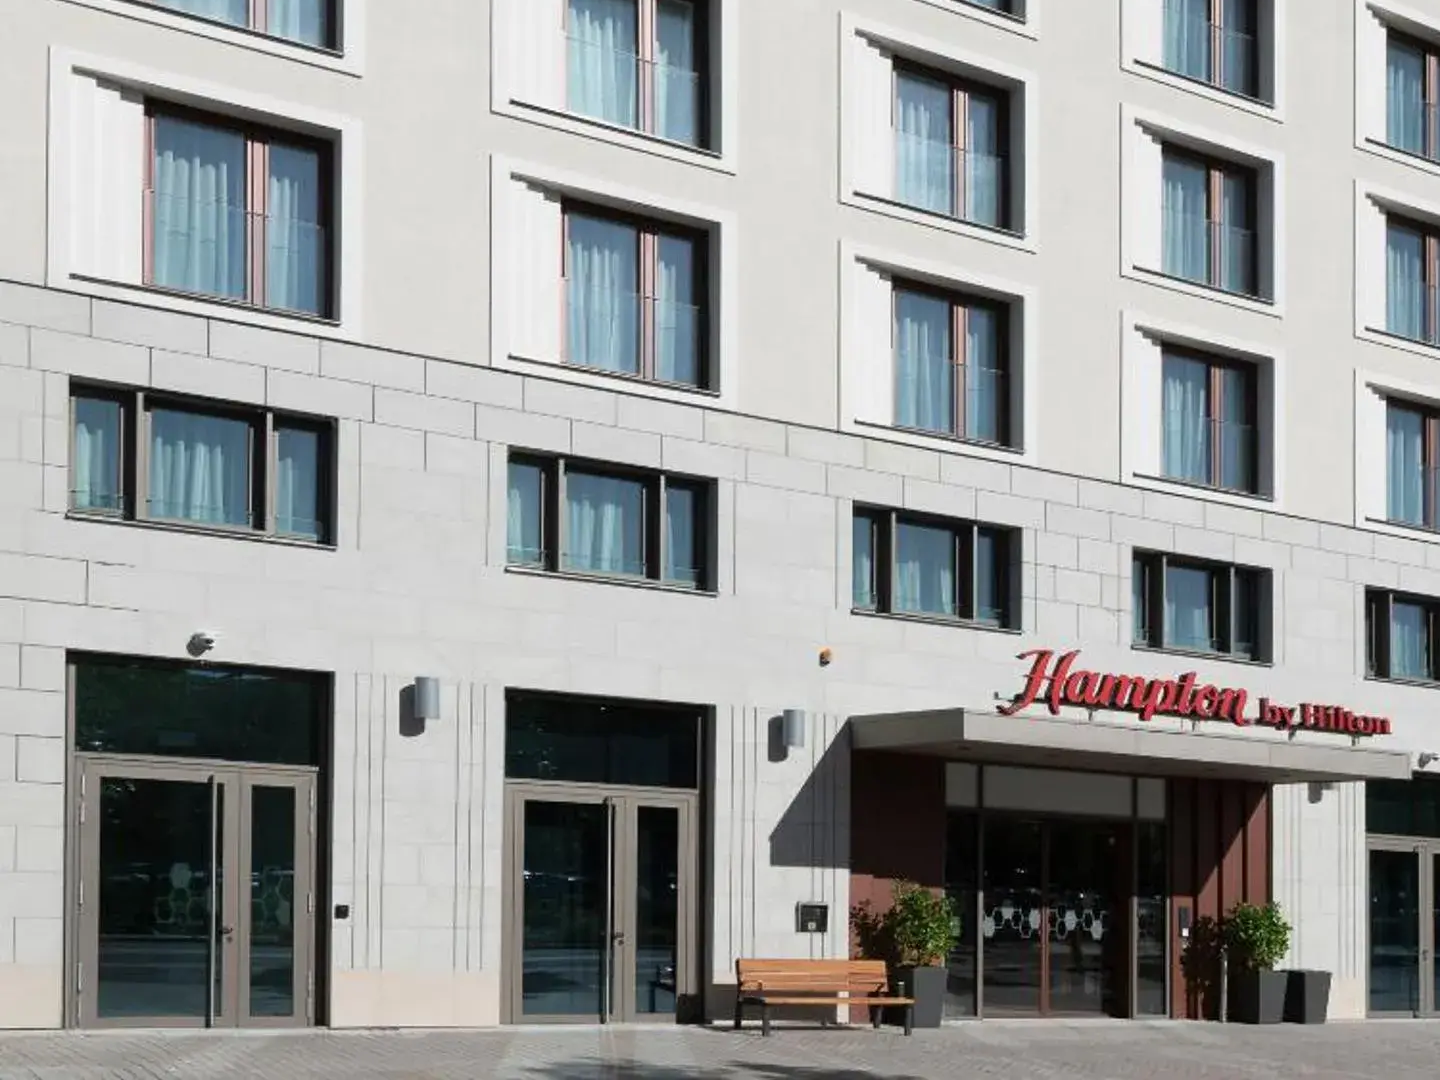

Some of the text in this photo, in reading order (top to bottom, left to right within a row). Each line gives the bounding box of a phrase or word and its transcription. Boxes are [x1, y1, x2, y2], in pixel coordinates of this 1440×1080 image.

[996, 649, 1392, 734] Hampton by Hilton
